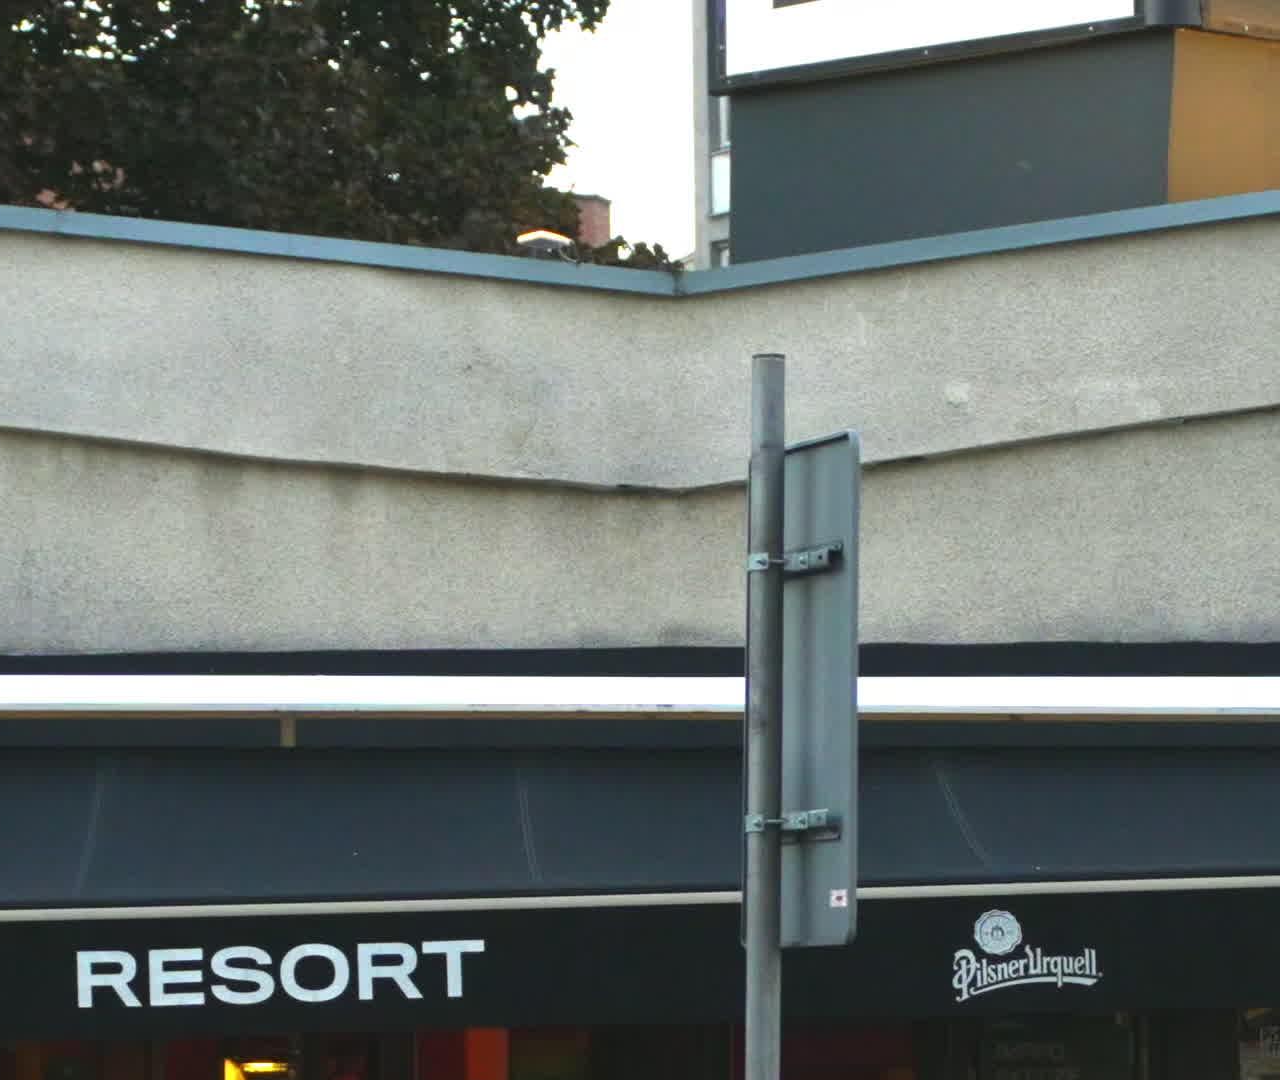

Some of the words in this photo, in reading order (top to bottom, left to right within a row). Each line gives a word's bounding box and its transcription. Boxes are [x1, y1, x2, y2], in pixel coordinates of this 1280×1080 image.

[77, 939, 486, 1008] RESORT
[952, 949, 1027, 1002] Pilsner
[1025, 944, 1097, 988] Urquell
